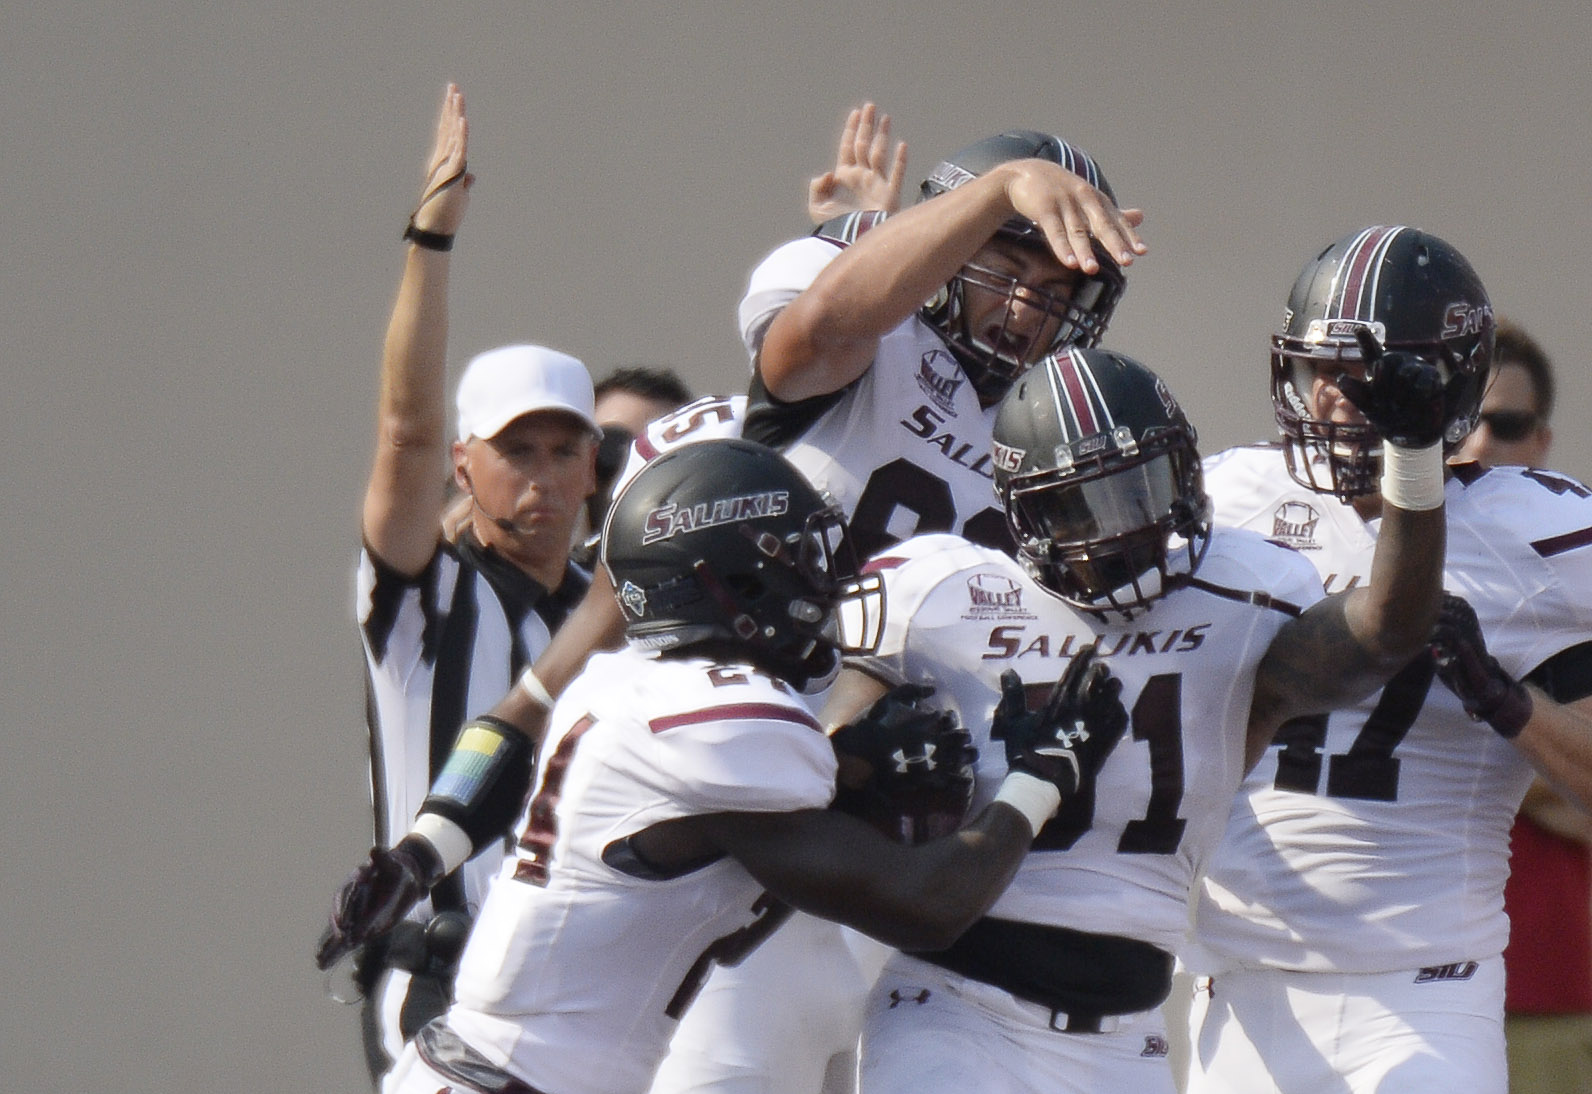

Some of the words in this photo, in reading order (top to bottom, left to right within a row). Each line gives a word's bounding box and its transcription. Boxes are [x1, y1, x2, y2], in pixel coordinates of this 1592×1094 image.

[642, 491, 790, 546] SALUKIS
[981, 623, 1212, 660] SALUKIS
[1413, 960, 1480, 985] SIU
